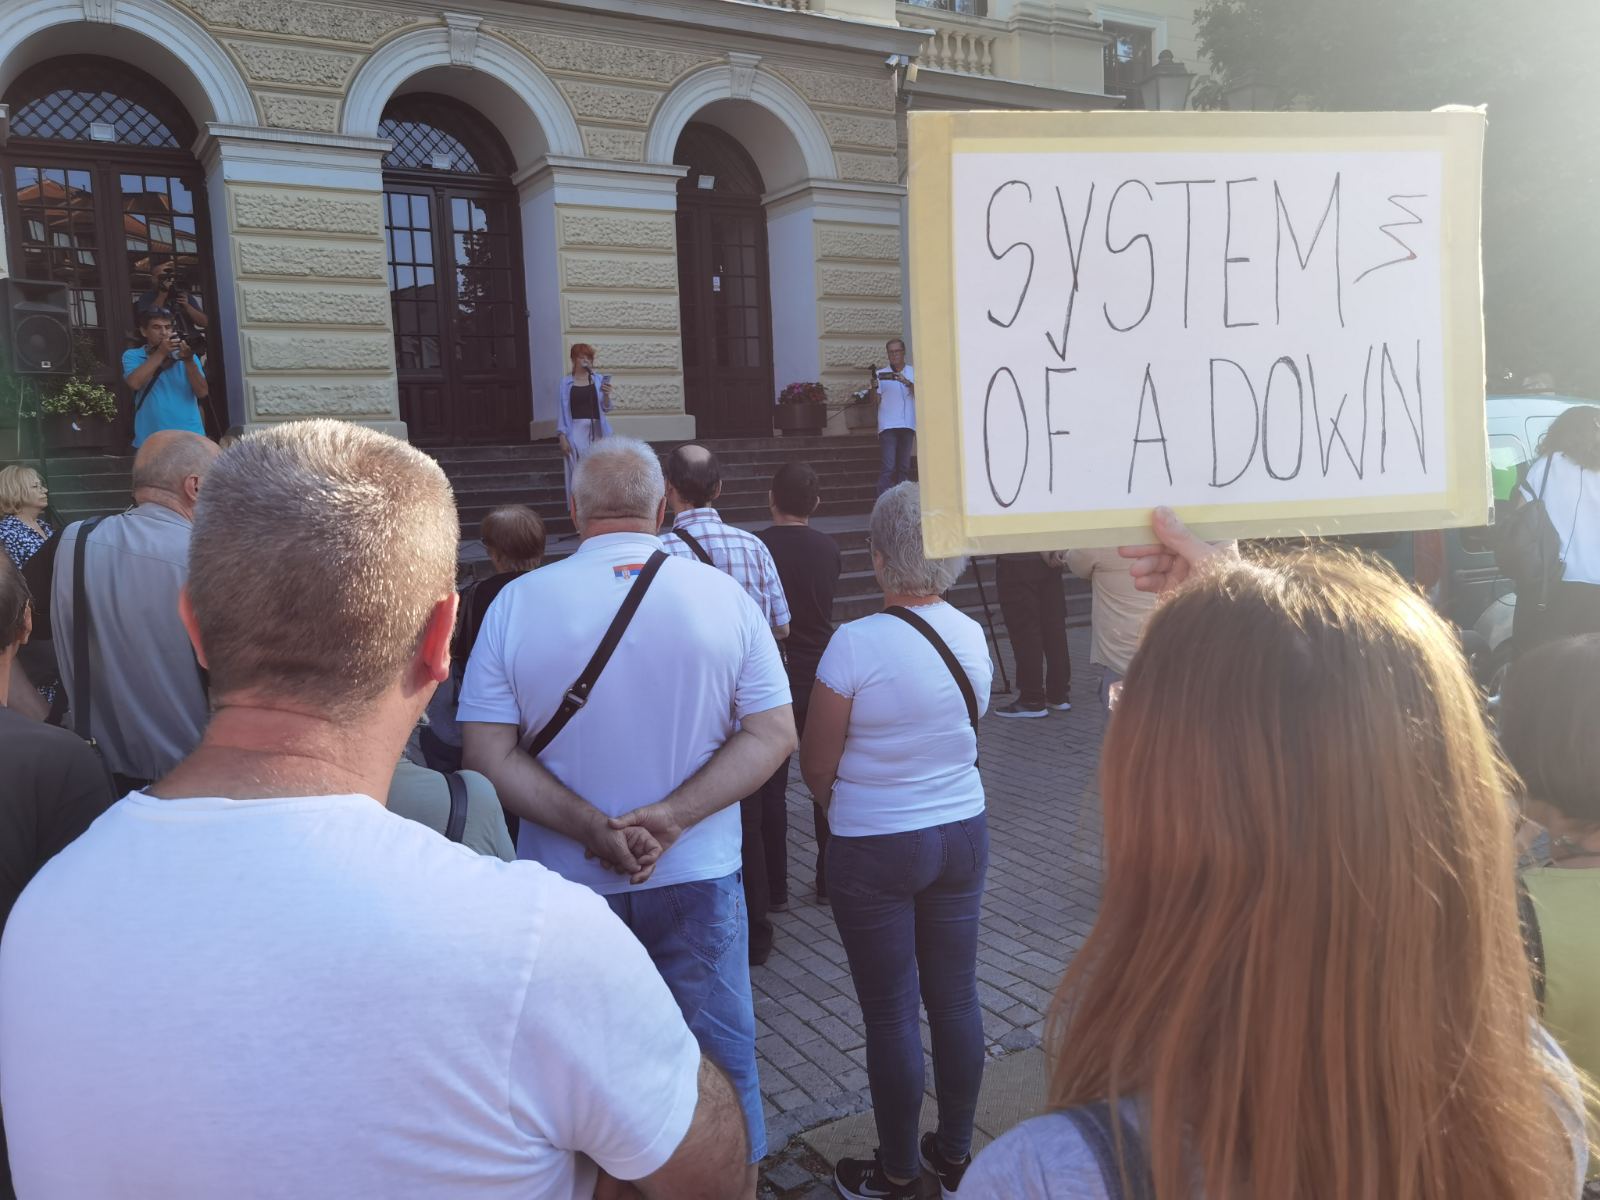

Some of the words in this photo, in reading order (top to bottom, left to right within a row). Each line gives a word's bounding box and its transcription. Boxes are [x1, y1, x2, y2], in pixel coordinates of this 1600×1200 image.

[986, 172, 1344, 361] SYSTEM
[983, 366, 1077, 508] OF
[1128, 363, 1172, 494] A
[1208, 339, 1427, 488] DOWN
